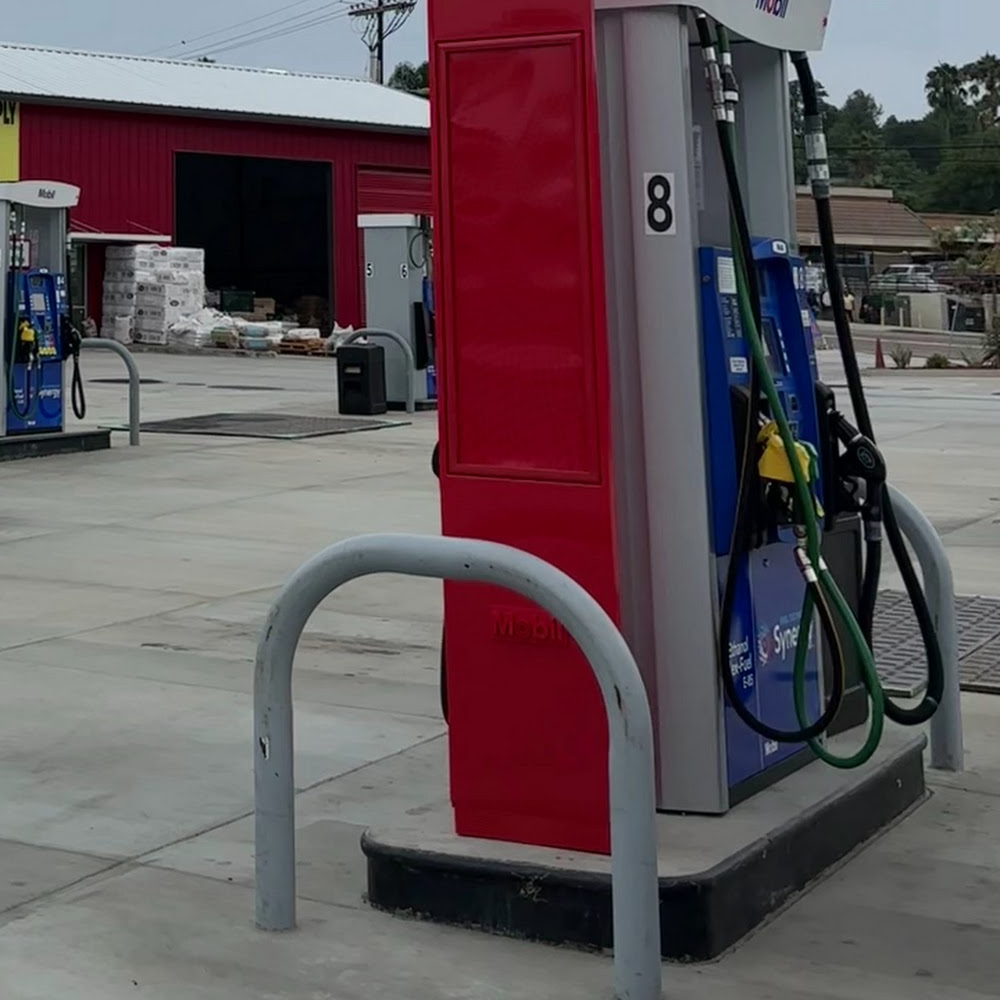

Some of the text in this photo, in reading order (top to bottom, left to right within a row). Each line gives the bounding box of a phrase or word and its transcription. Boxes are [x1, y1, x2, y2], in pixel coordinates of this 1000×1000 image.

[38, 188, 56, 200] Mobil
[647, 174, 673, 233] 8
[367, 262, 373, 277] 5
[402, 264, 407, 278] 6
[773, 619, 812, 660] Syne
